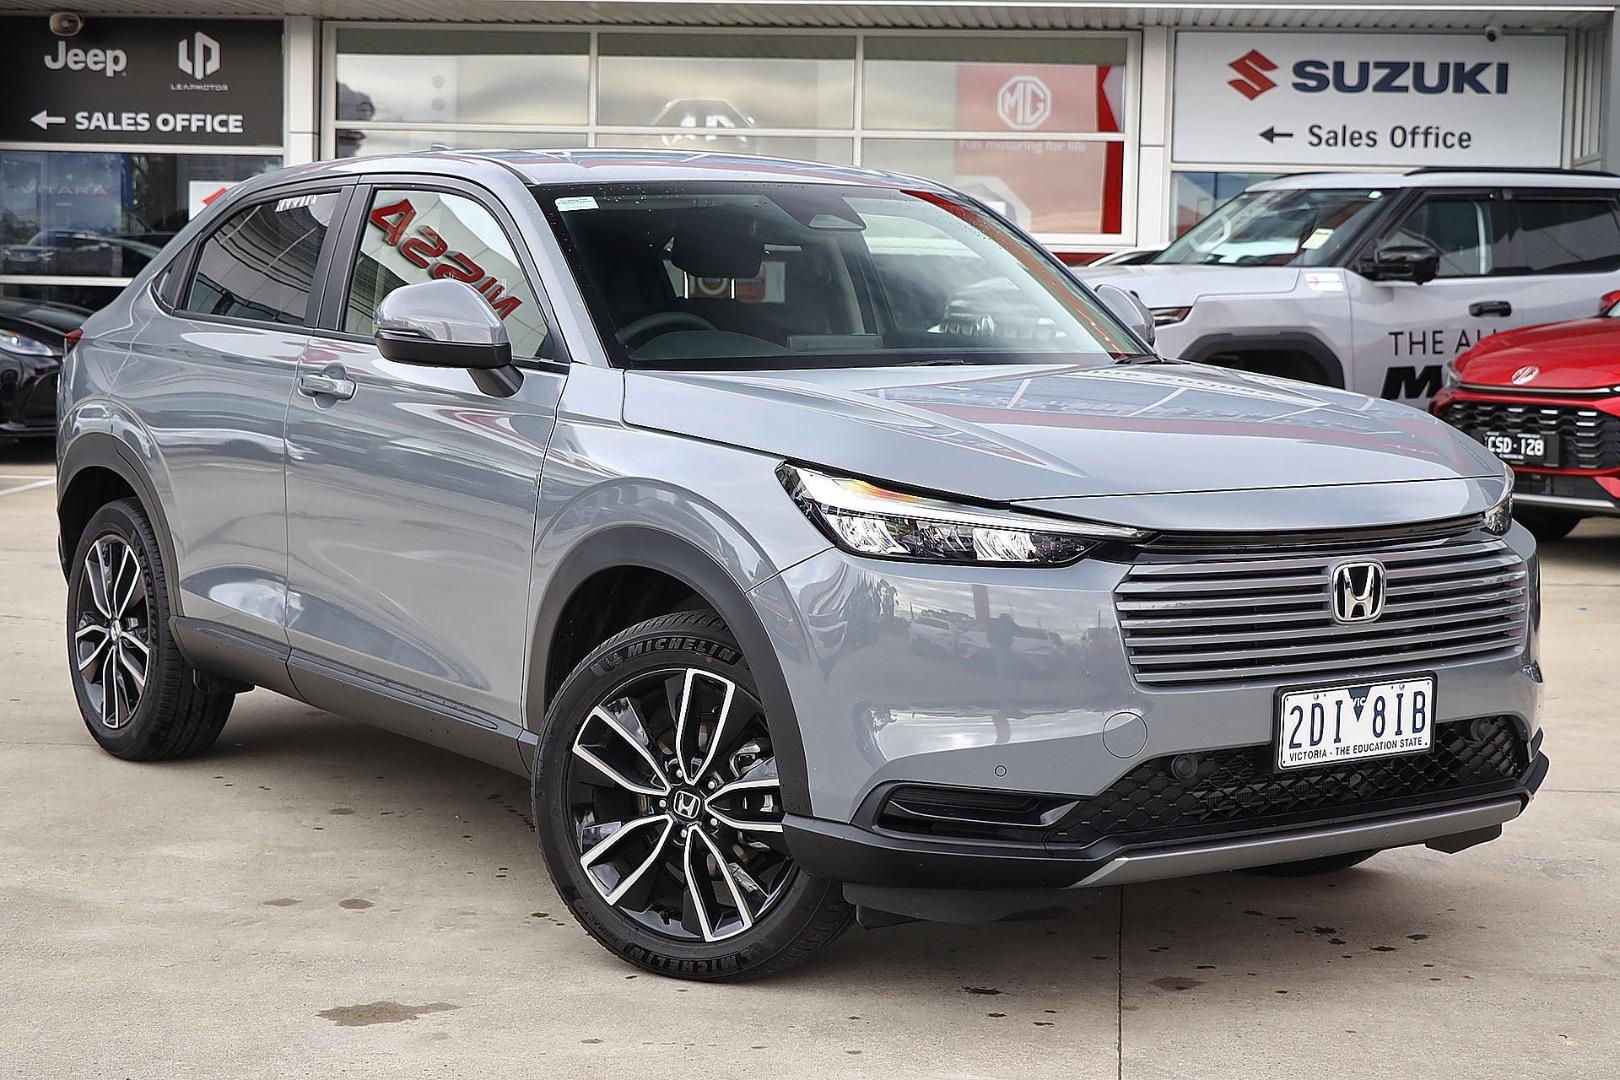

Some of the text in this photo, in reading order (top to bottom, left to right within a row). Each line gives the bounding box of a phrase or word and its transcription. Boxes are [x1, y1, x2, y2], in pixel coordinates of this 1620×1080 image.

[44, 40, 127, 77] Jeep
[1292, 60, 1509, 95] SUZUKI
[1002, 81, 1046, 126] MG
[75, 111, 244, 134] SALES OFFICE
[1308, 125, 1472, 149] Sales Office
[1388, 330, 1444, 356] THE
[627, 637, 736, 661] MICHELIN
[1352, 695, 1367, 707] VIC
[1289, 750, 1327, 762] VICTORIA
[1335, 745, 1350, 757] THE
[1352, 738, 1397, 754] EDUCATION
[1399, 736, 1423, 749] STATE
[628, 945, 738, 973] MICHELIN
